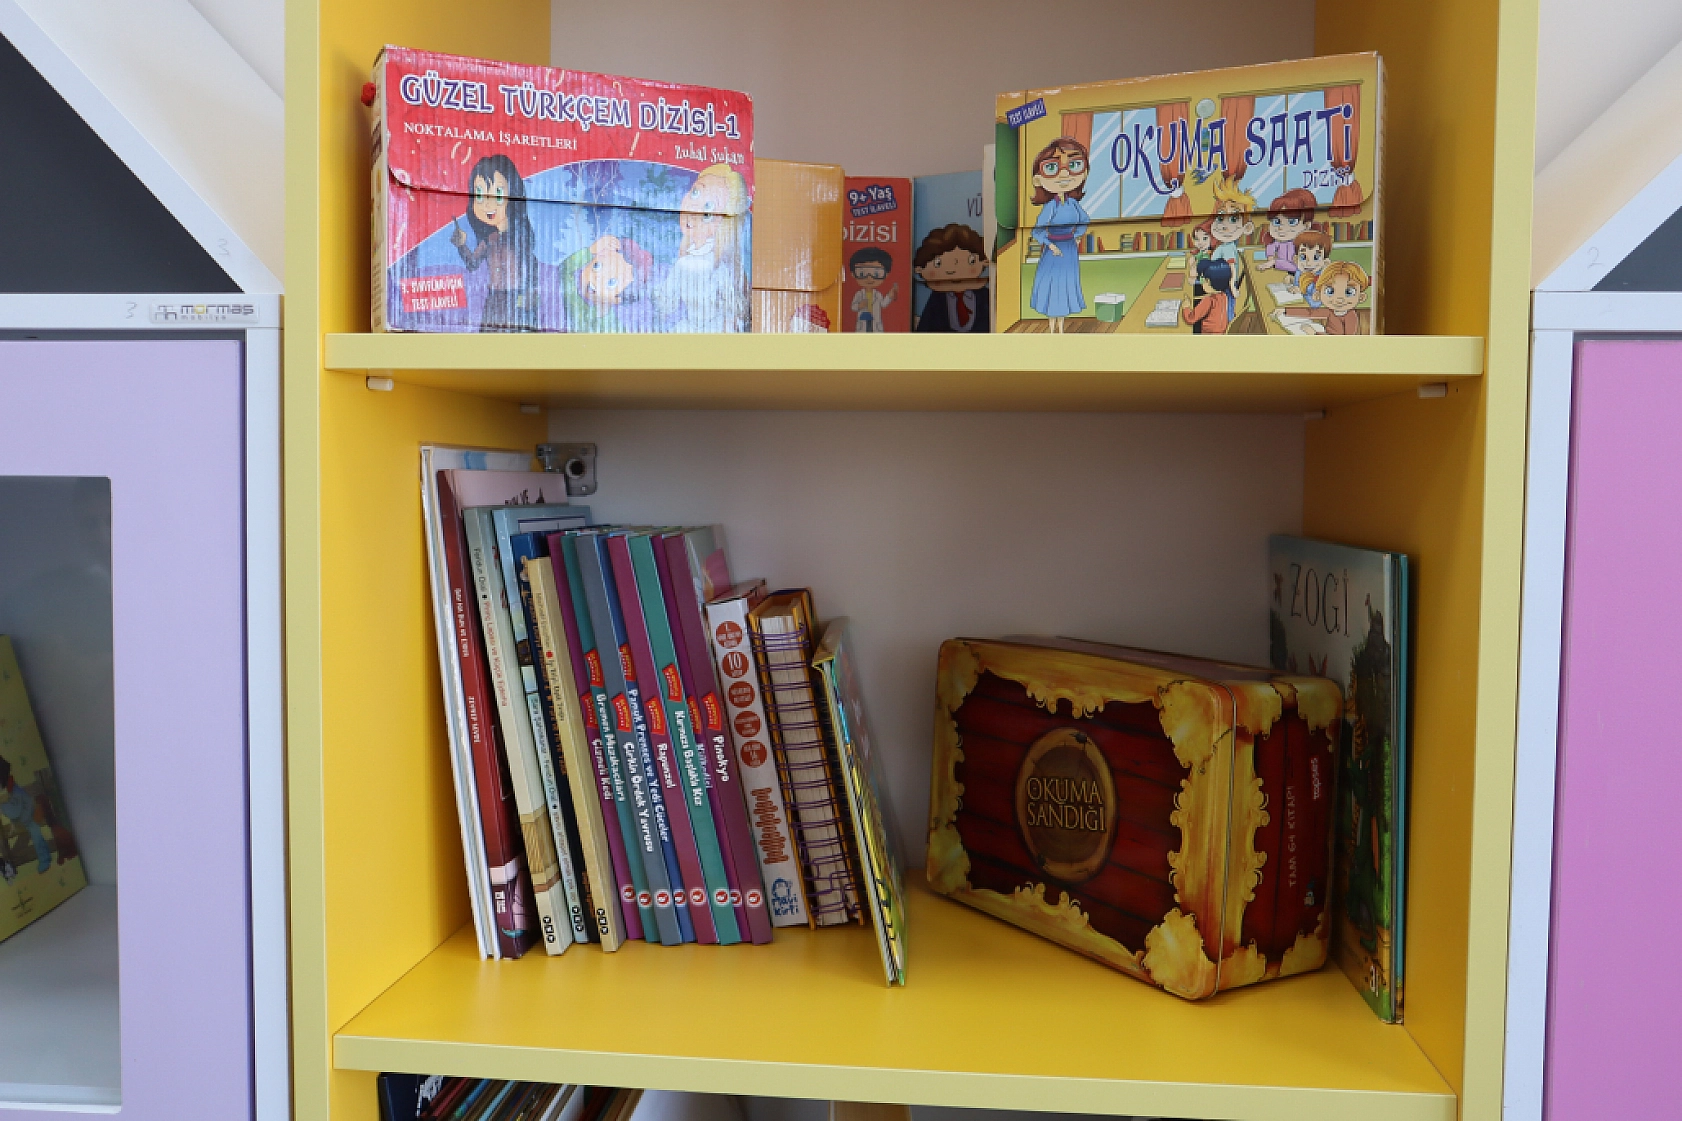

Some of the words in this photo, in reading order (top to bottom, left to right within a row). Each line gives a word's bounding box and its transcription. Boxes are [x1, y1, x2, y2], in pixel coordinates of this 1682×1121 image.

[400, 70, 494, 113] GÜZEL
[499, 82, 631, 132] TÜRKÇEM
[639, 97, 741, 139] DİZİSİ-1
[403, 121, 495, 143] NOKTALAMA
[499, 130, 577, 151] İŞARETLERİ
[1111, 117, 1227, 198] OKUMA
[849, 190, 867, 205] 9+
[868, 186, 892, 202] Yaş
[628, 689, 643, 723] Pamuk
[636, 723, 651, 763] Prenses
[713, 735, 729, 782] Pinokyo
[645, 764, 654, 777] ve
[657, 743, 677, 788] Rapunzel
[601, 776, 613, 800] Kedi
[623, 741, 637, 774] Çirkin
[631, 775, 645, 808] Ördek
[638, 808, 653, 852] Yavrusu
[648, 779, 662, 803] Yedi
[1027, 777, 1103, 804] OKUMA
[1027, 802, 1106, 831] SANDIĞI
[1288, 856, 1297, 888] TAM
